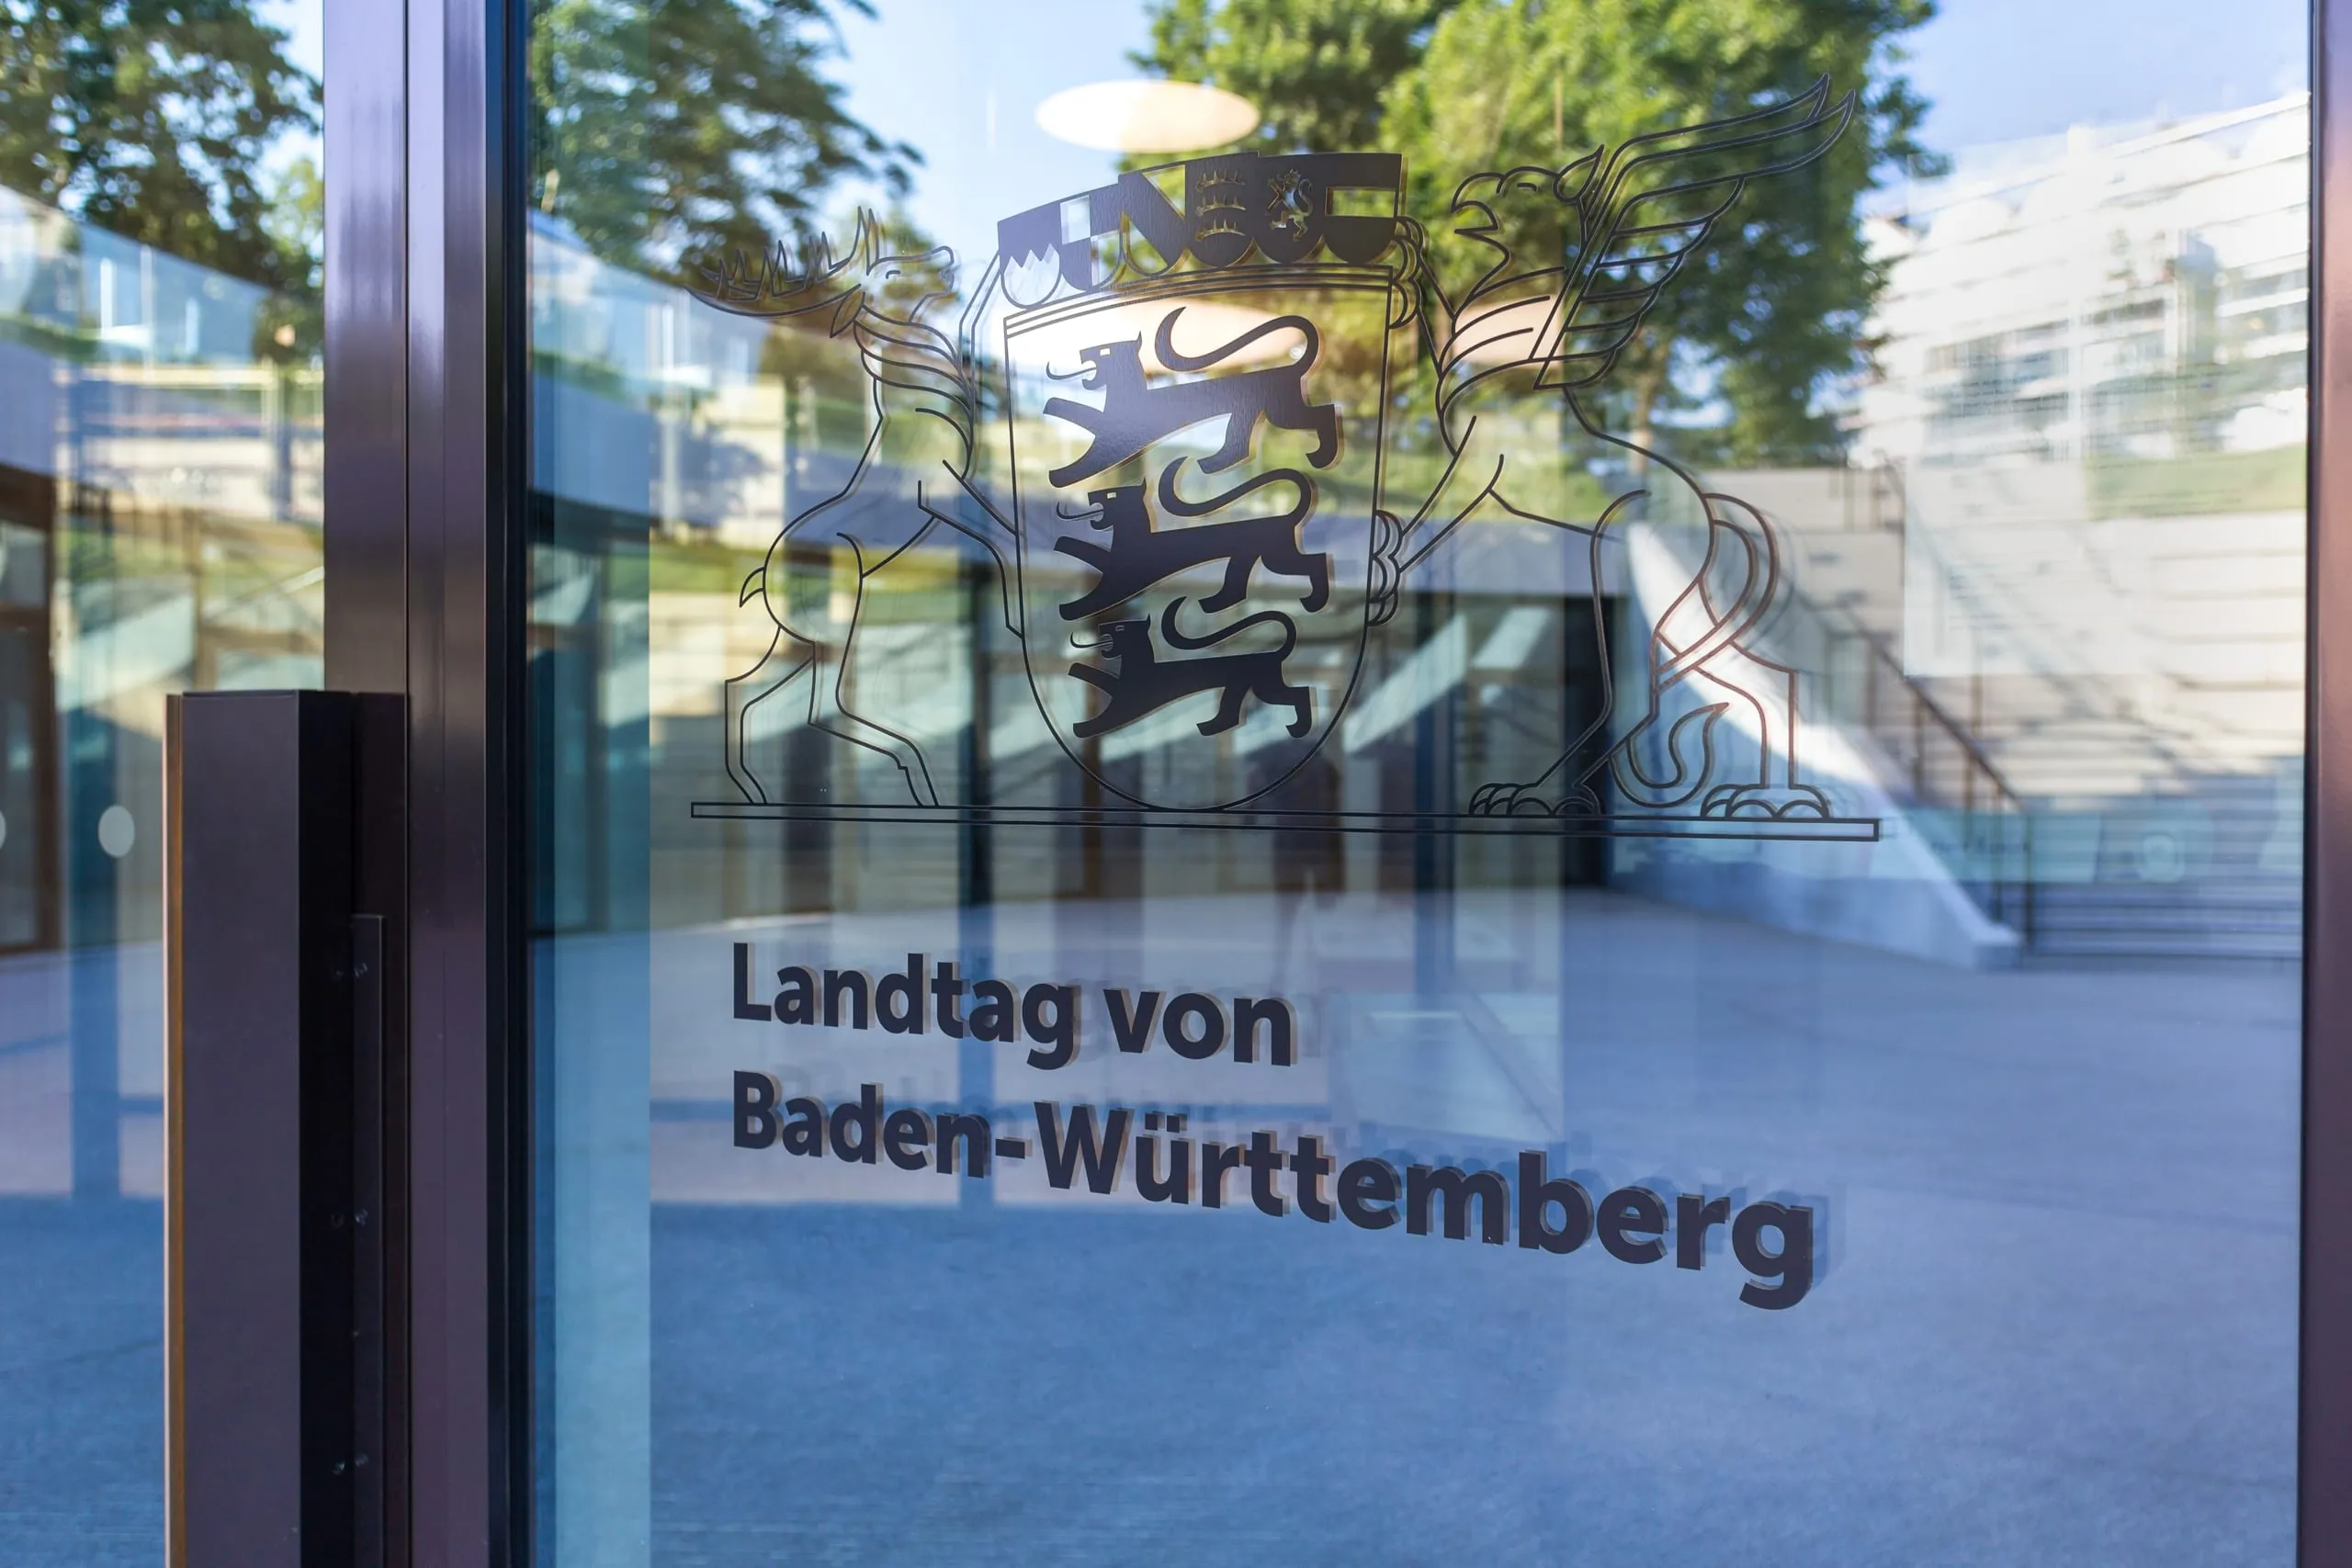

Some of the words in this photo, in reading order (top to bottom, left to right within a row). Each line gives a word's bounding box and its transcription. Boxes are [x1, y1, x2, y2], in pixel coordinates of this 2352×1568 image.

[733, 942, 1077, 1070] Landtag
[1102, 988, 1292, 1066] von
[733, 1070, 1814, 1310] Baden-Württemberg
